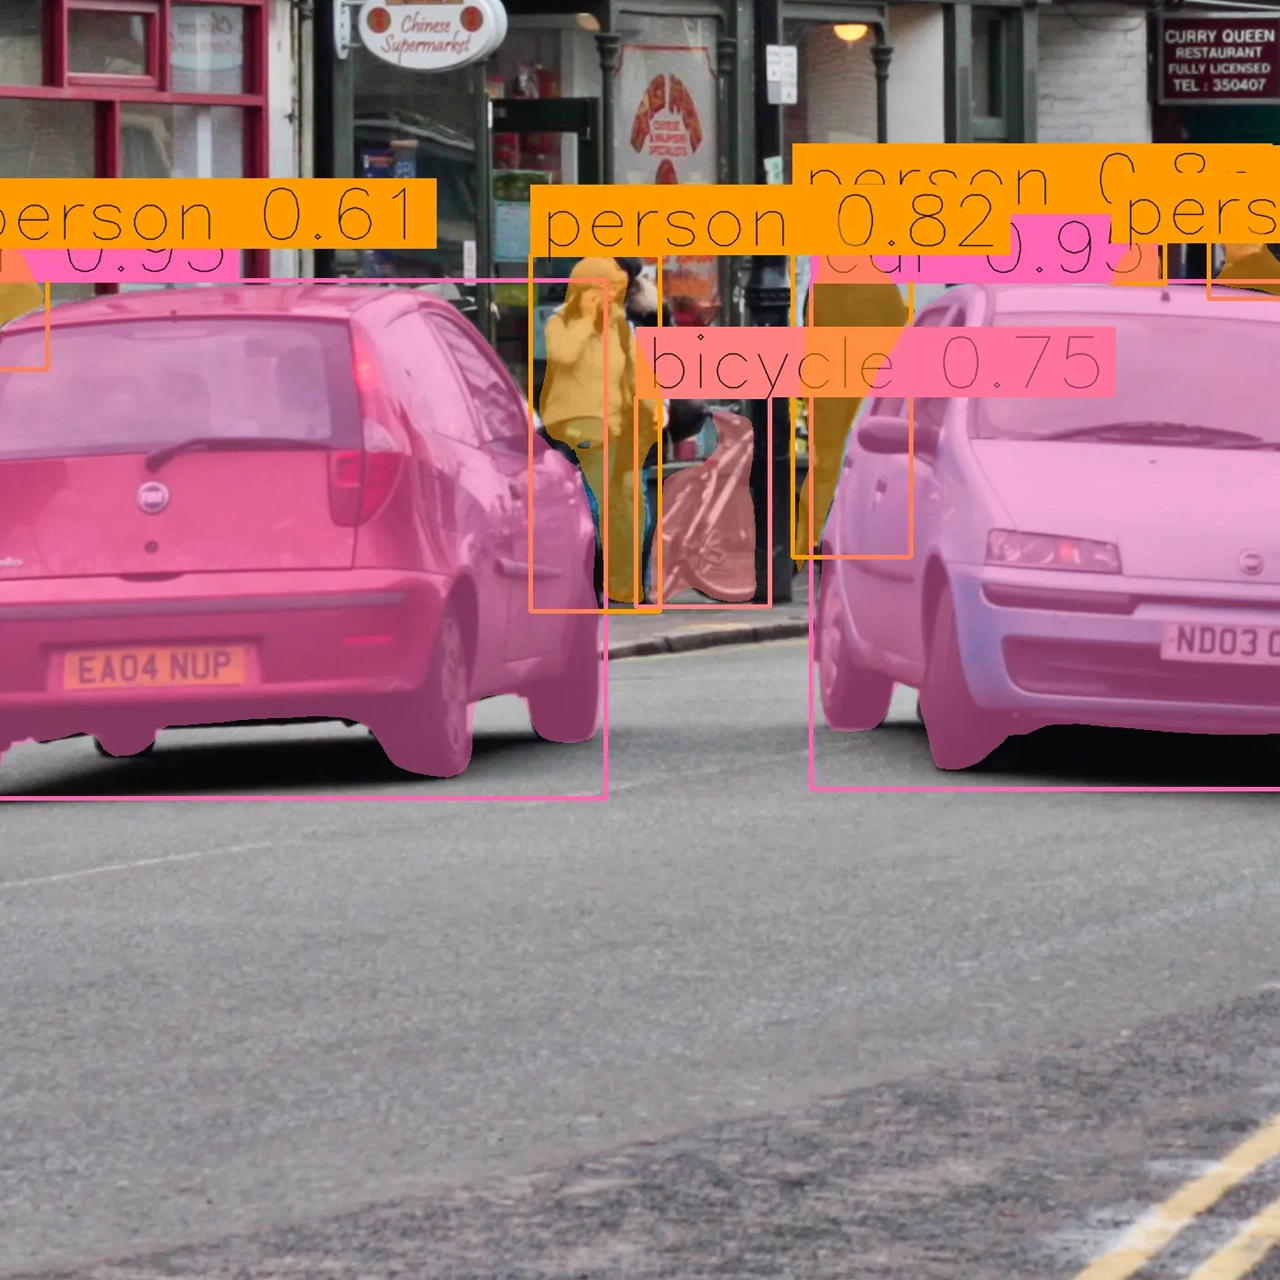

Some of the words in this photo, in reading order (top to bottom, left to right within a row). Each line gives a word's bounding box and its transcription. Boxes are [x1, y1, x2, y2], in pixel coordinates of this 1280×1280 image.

[401, 11, 451, 33] Chinese
[1165, 29, 1217, 43] CURRY
[1222, 29, 1275, 42] QUEEN
[381, 30, 472, 63] Supermarket
[1175, 46, 1262, 59] RESTAURANT
[1168, 63, 1206, 74] FULLY
[1209, 63, 1271, 74] LICENSED
[1173, 79, 1199, 91] TEL
[1212, 79, 1267, 91] 350407
[1176, 624, 1259, 656] ND03
[78, 653, 159, 684] EA04
[169, 651, 232, 680] NUP
